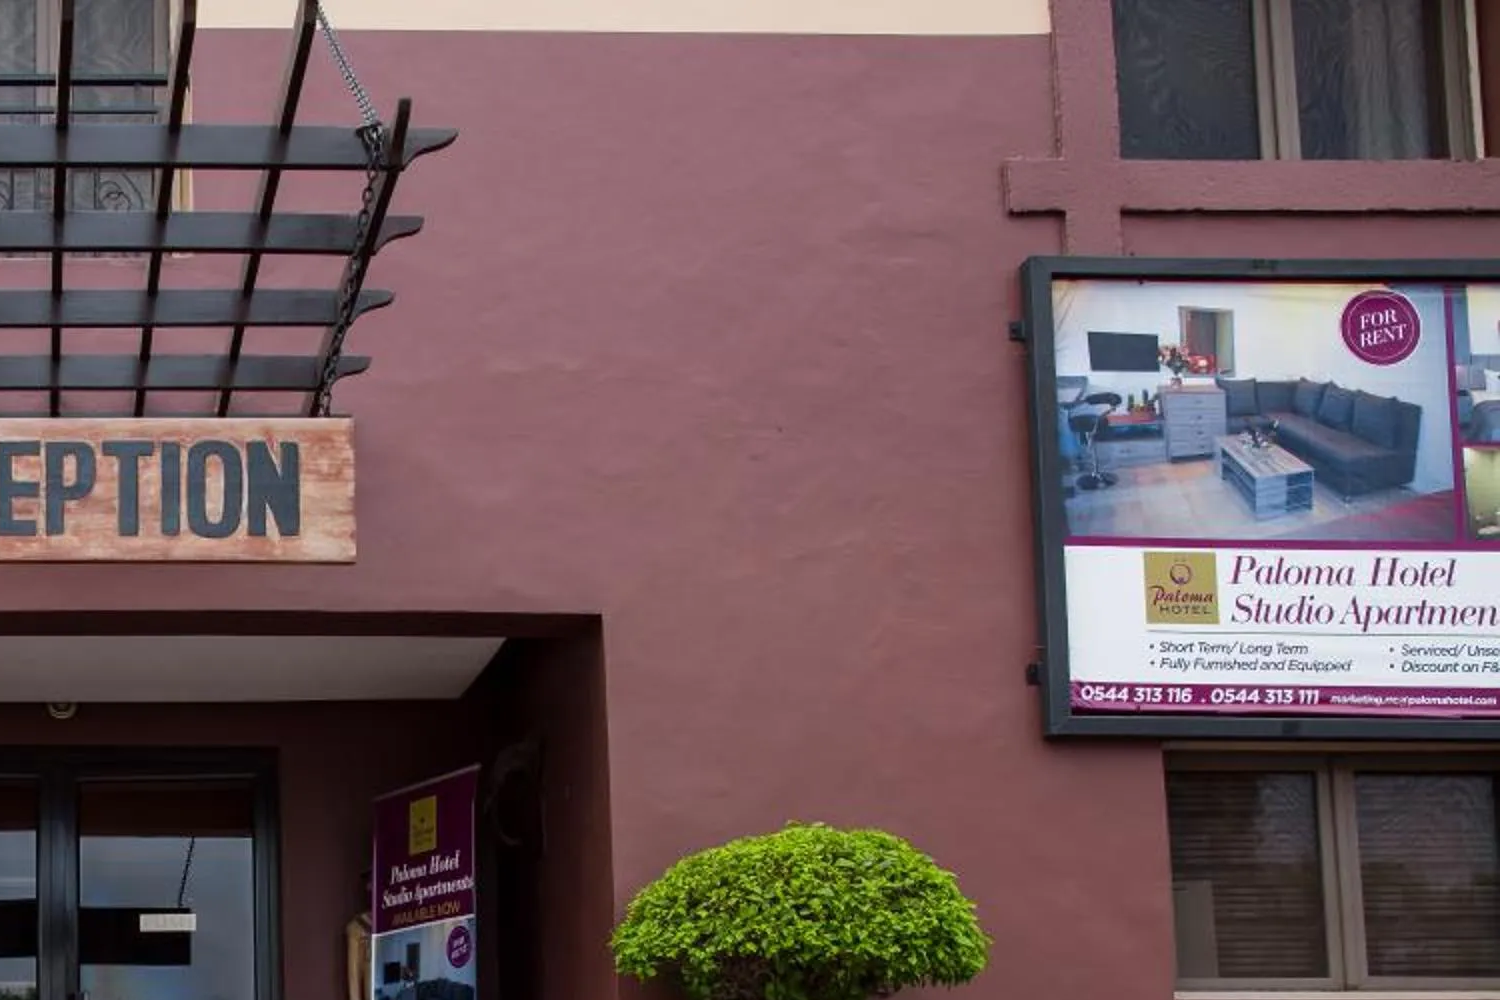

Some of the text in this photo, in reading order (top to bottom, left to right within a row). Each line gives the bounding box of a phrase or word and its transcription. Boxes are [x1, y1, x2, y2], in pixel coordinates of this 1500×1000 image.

[1361, 308, 1398, 330] FOR
[1361, 324, 1407, 348] RENT
[1226, 555, 1457, 587] Paloma Hotel
[1150, 585, 1214, 616] Paloma HOTEL
[1230, 593, 1335, 626] Studio
[1159, 641, 1194, 653] Short
[1239, 642, 1273, 657] Long
[1276, 643, 1309, 655] Term
[1160, 657, 1353, 672] Fully Furnished and Equipped
[1401, 660, 1460, 673] Discount
[1461, 663, 1479, 673] on
[1080, 685, 1320, 705] 0544 313 116 0544 313 111
[429, 850, 461, 875] Hotel
[437, 899, 461, 917] NOW
